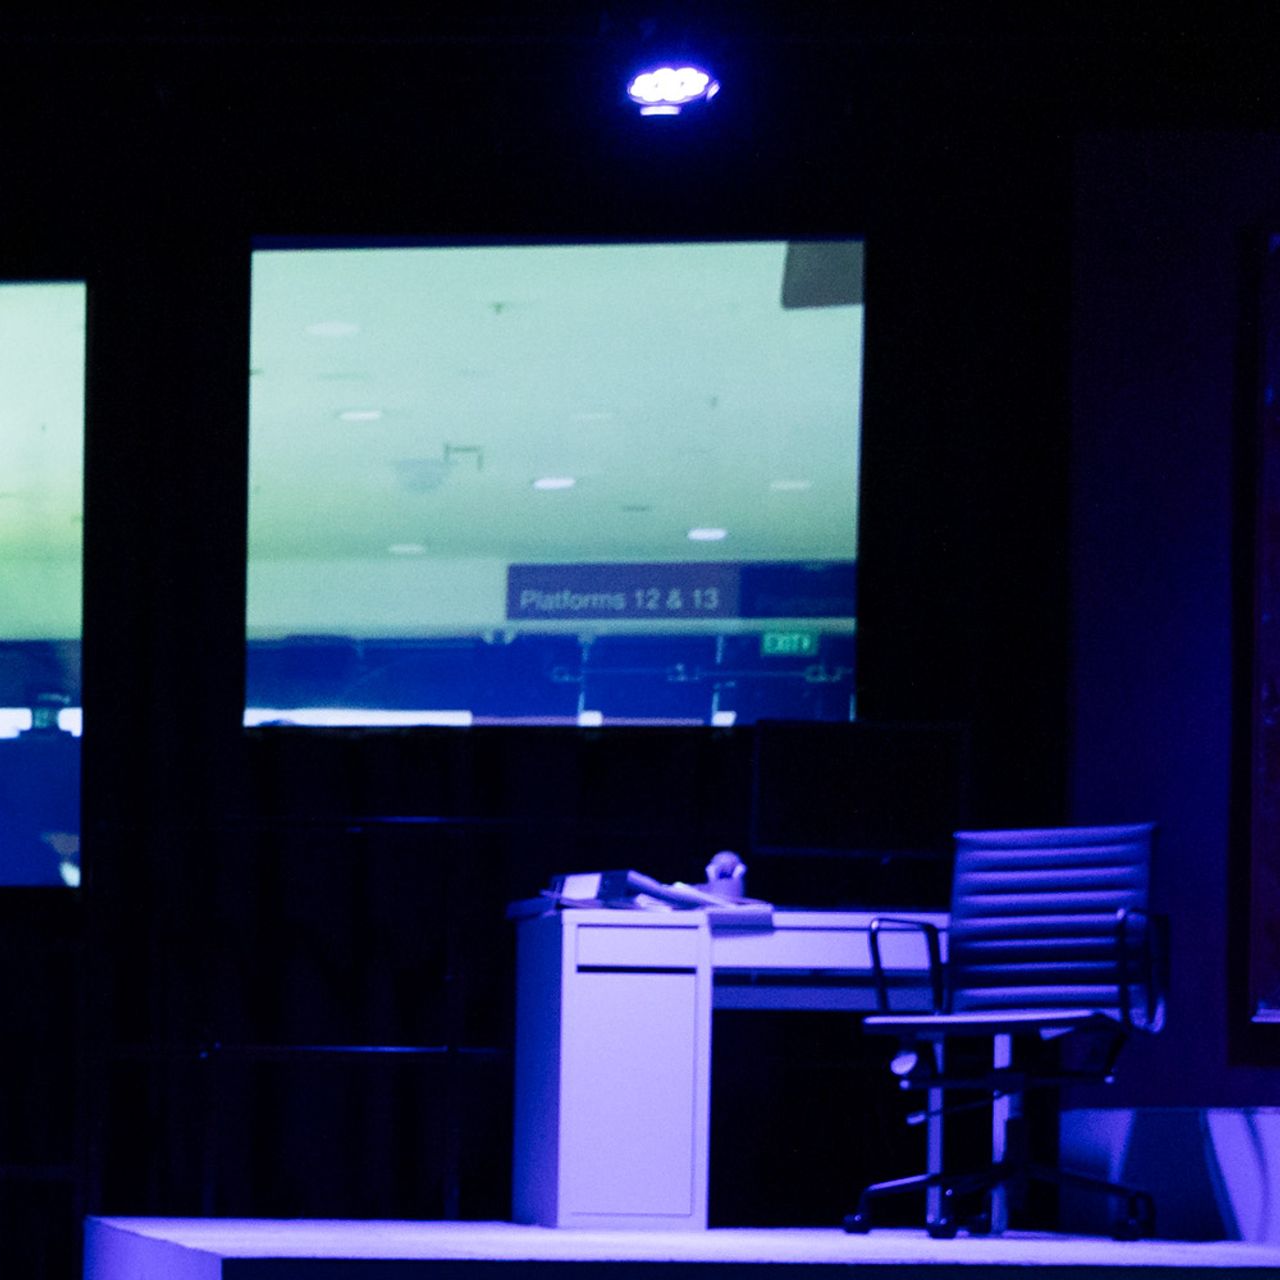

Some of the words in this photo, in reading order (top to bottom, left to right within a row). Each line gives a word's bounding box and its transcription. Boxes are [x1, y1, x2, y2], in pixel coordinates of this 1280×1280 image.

[520, 588, 626, 611] Platforms
[634, 588, 661, 610] 12
[666, 588, 682, 610] &
[692, 587, 719, 610] 13
